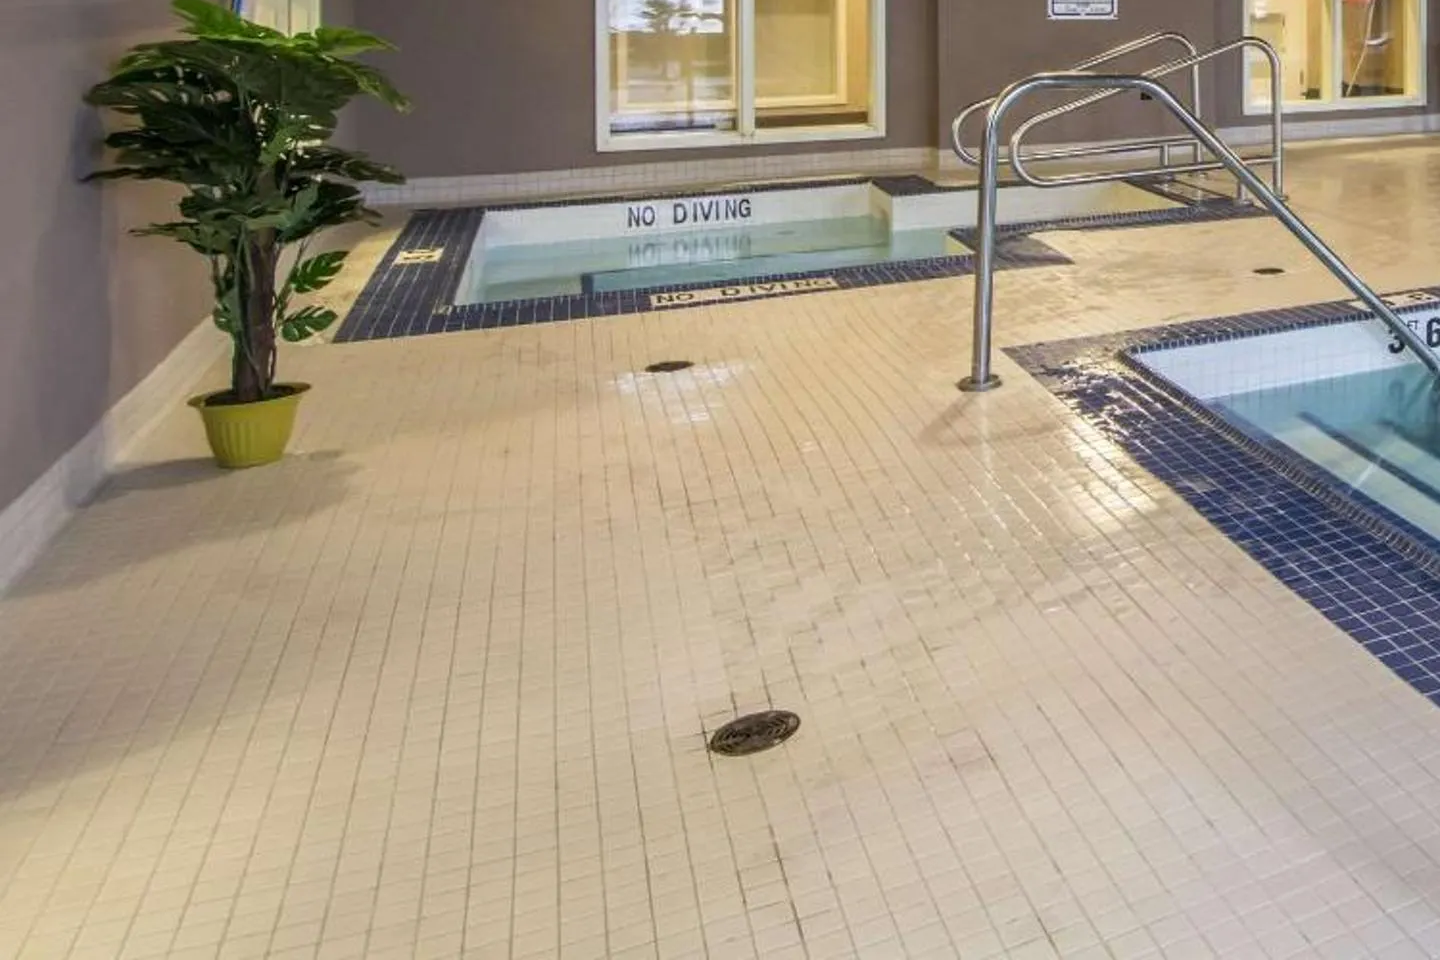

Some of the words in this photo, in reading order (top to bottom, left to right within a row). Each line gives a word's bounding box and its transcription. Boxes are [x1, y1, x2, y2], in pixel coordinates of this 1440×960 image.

[628, 206, 655, 227] NO
[673, 199, 752, 225] DIVING
[656, 292, 694, 304] NO
[720, 279, 832, 297] DIVING
